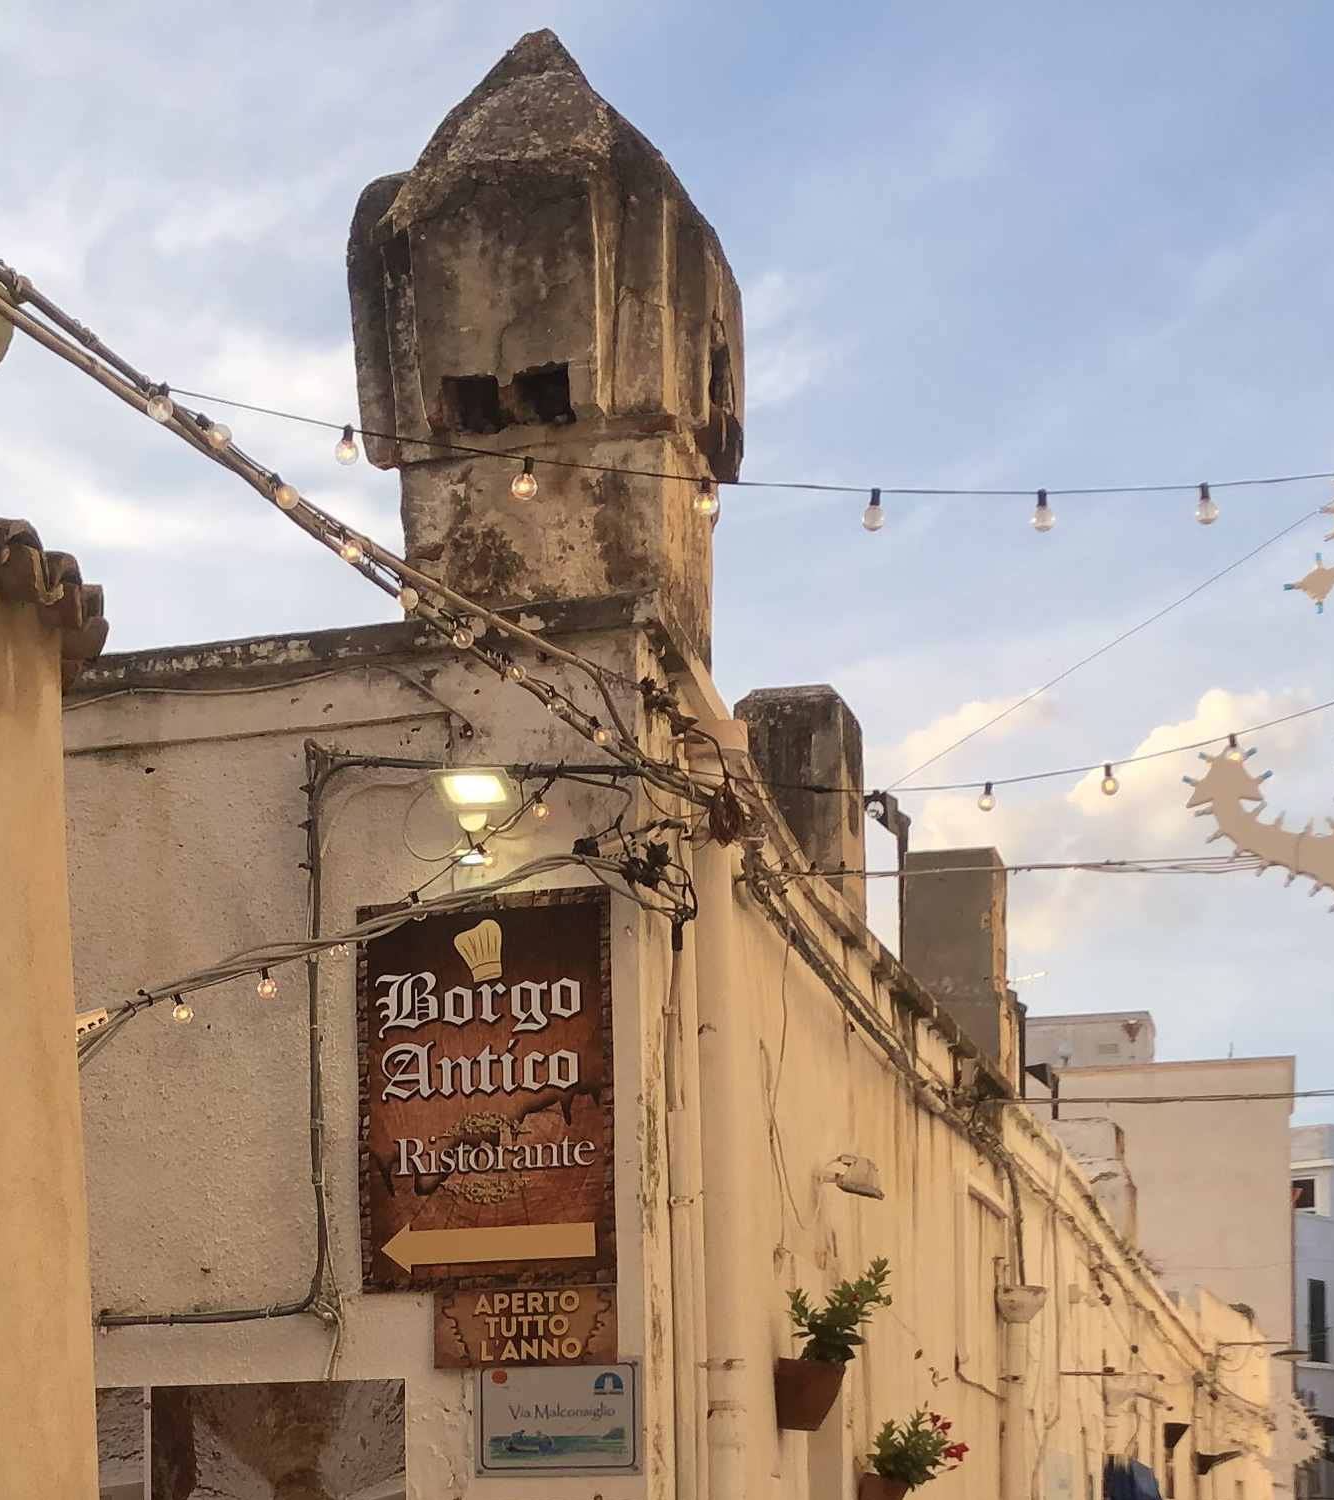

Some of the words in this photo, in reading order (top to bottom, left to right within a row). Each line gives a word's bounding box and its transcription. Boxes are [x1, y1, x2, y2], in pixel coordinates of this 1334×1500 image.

[375, 971, 582, 1040] Borgo
[380, 1040, 579, 1101] Antico
[394, 1136, 597, 1177] Ristorante
[473, 1290, 580, 1317] APERTO
[484, 1314, 569, 1340] TUTTO
[480, 1336, 582, 1362] L'ANNO
[509, 1403, 531, 1421] Via
[534, 1402, 616, 1422] Malconsiglio
